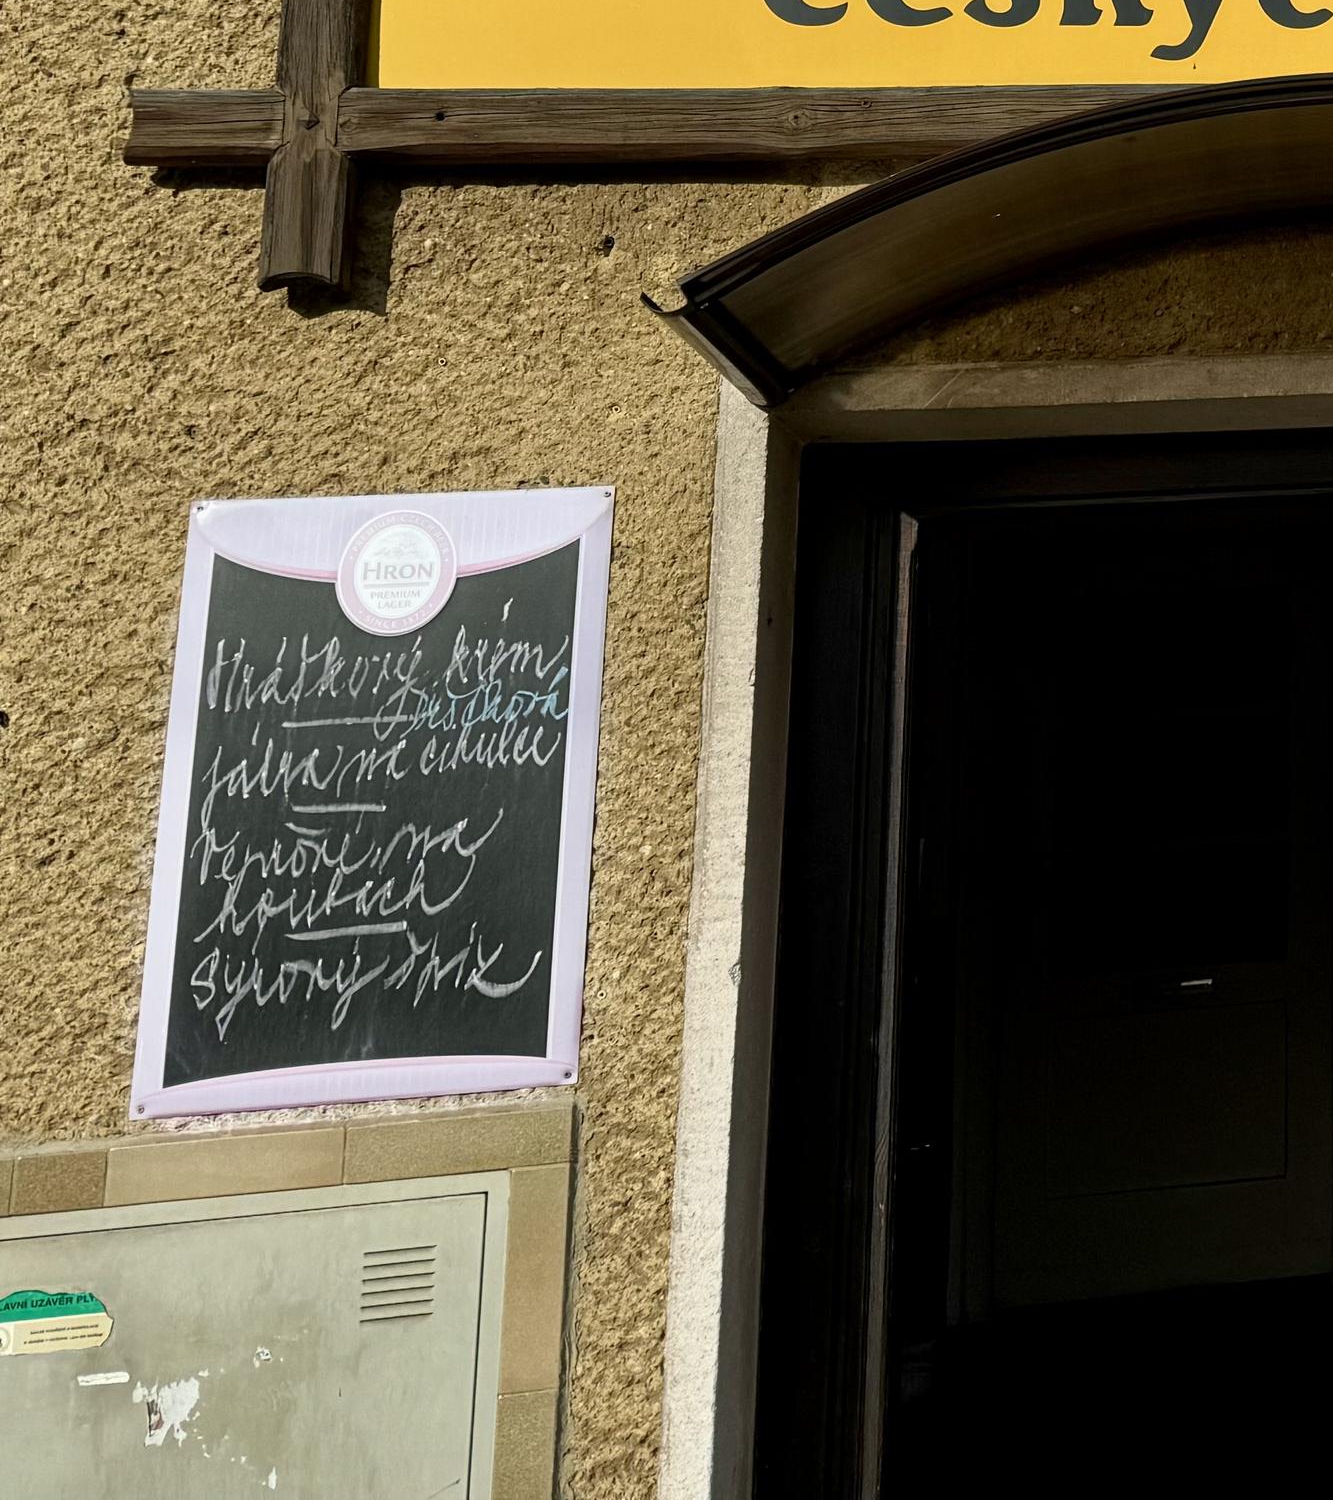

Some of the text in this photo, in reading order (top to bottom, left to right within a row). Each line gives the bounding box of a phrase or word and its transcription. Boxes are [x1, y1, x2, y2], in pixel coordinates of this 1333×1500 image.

[362, 561, 435, 580] HRON
[370, 589, 421, 599] PREMIUM
[378, 600, 413, 609] LAGER
